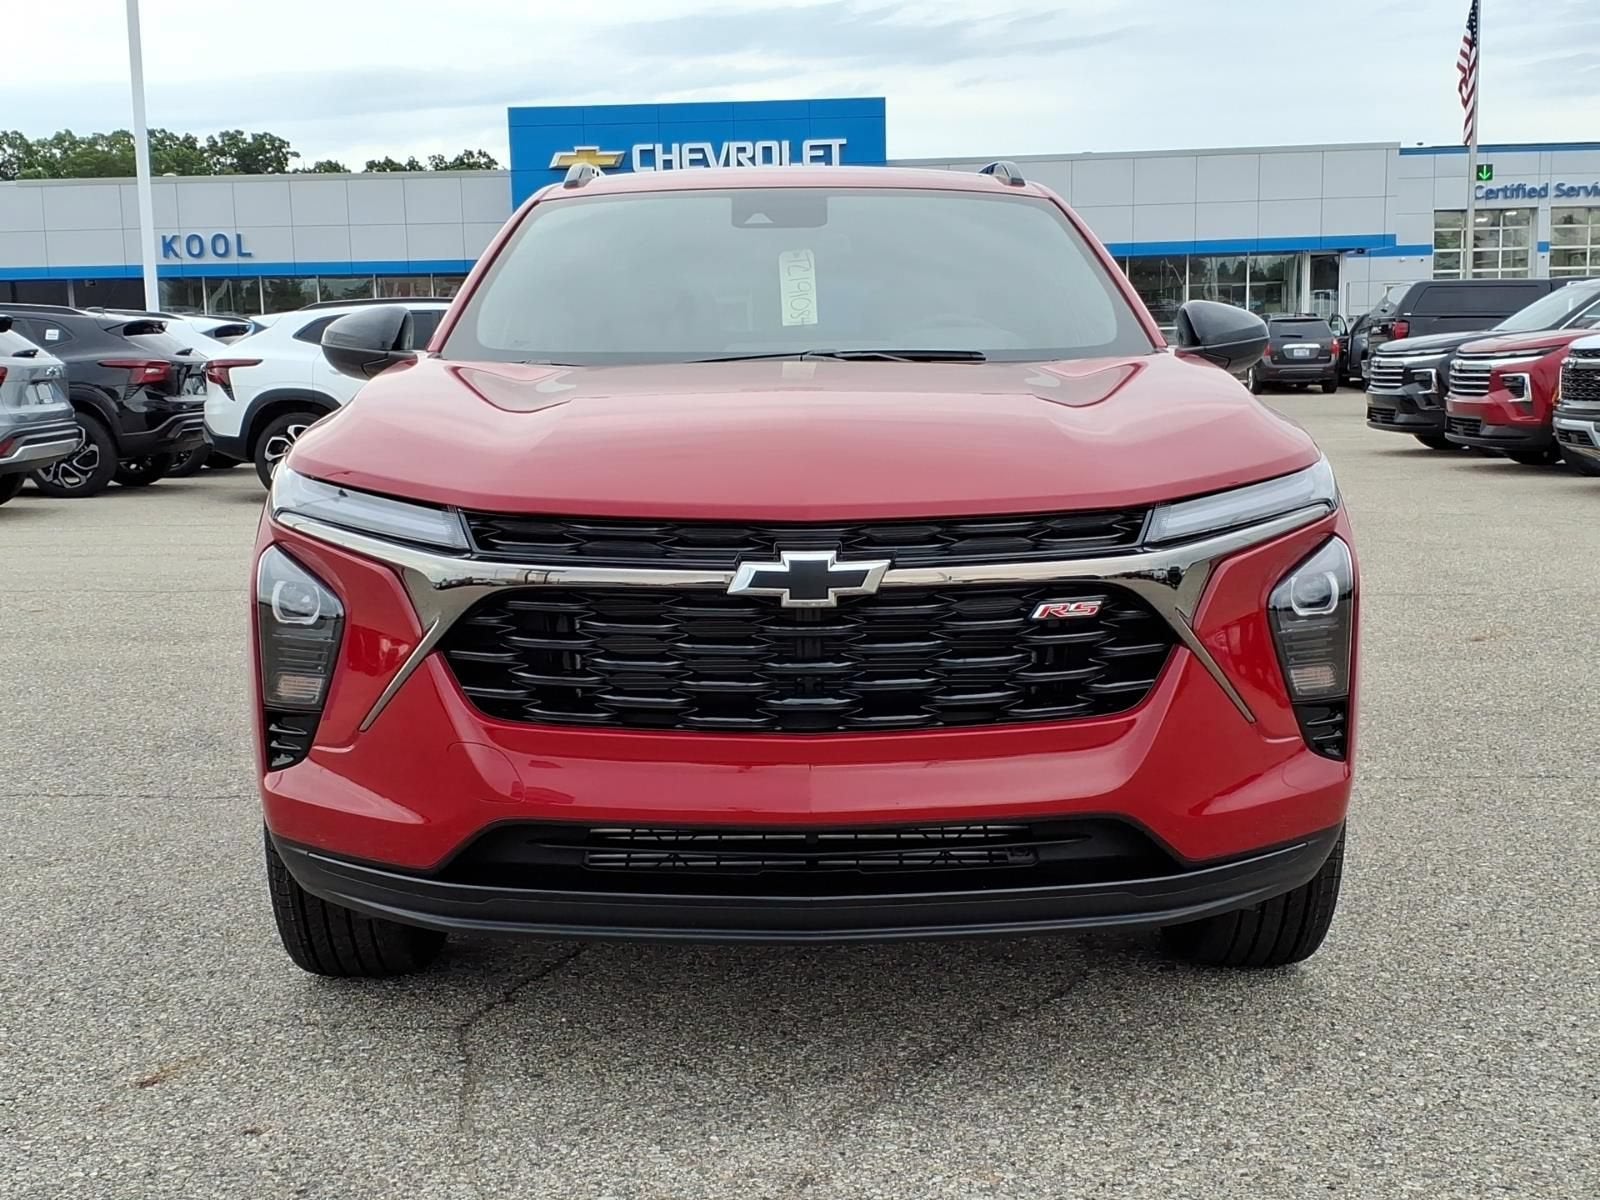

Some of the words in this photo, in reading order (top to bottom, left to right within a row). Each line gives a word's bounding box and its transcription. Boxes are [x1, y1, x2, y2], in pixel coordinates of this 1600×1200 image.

[632, 138, 847, 172] CHEVROLET
[1474, 182, 1548, 200] Certified
[1554, 182, 1600, 198] Servi
[161, 233, 253, 259] KOOL
[1033, 601, 1101, 618] RS
